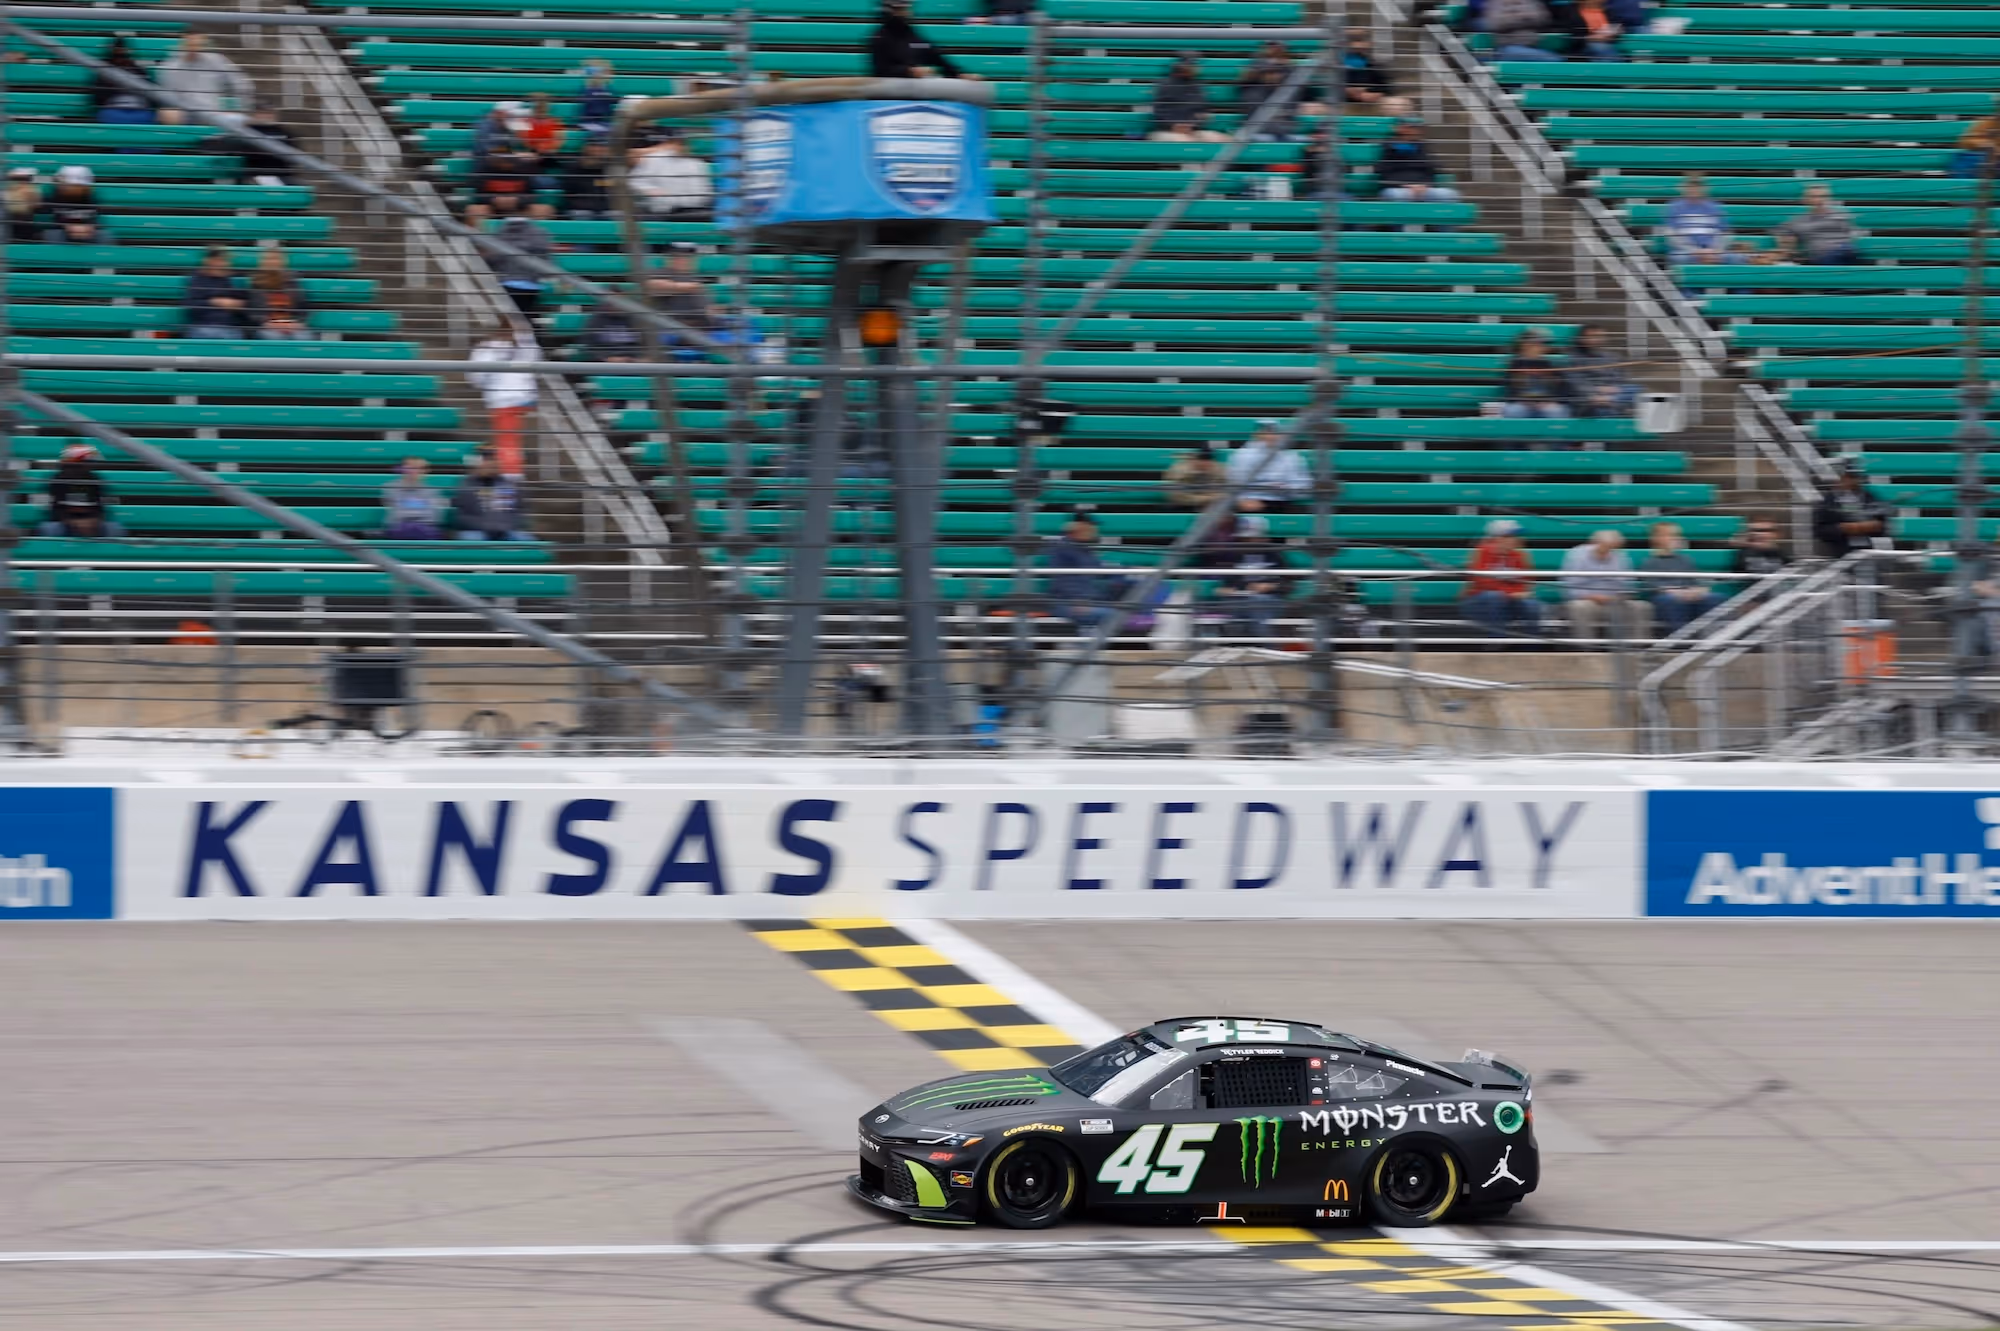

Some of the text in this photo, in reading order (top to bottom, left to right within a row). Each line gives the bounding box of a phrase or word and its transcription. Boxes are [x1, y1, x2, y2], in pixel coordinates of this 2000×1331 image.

[181, 798, 1586, 897] KANSAS SPEEDWAY
[0, 853, 73, 907] th
[1174, 1019, 1290, 1043] 45
[1003, 1122, 1065, 1137] GOODYEAR
[1301, 1137, 1387, 1151] ENERGY
[1096, 1123, 1220, 1194] 45
[1315, 1208, 1341, 1218] Mobil
